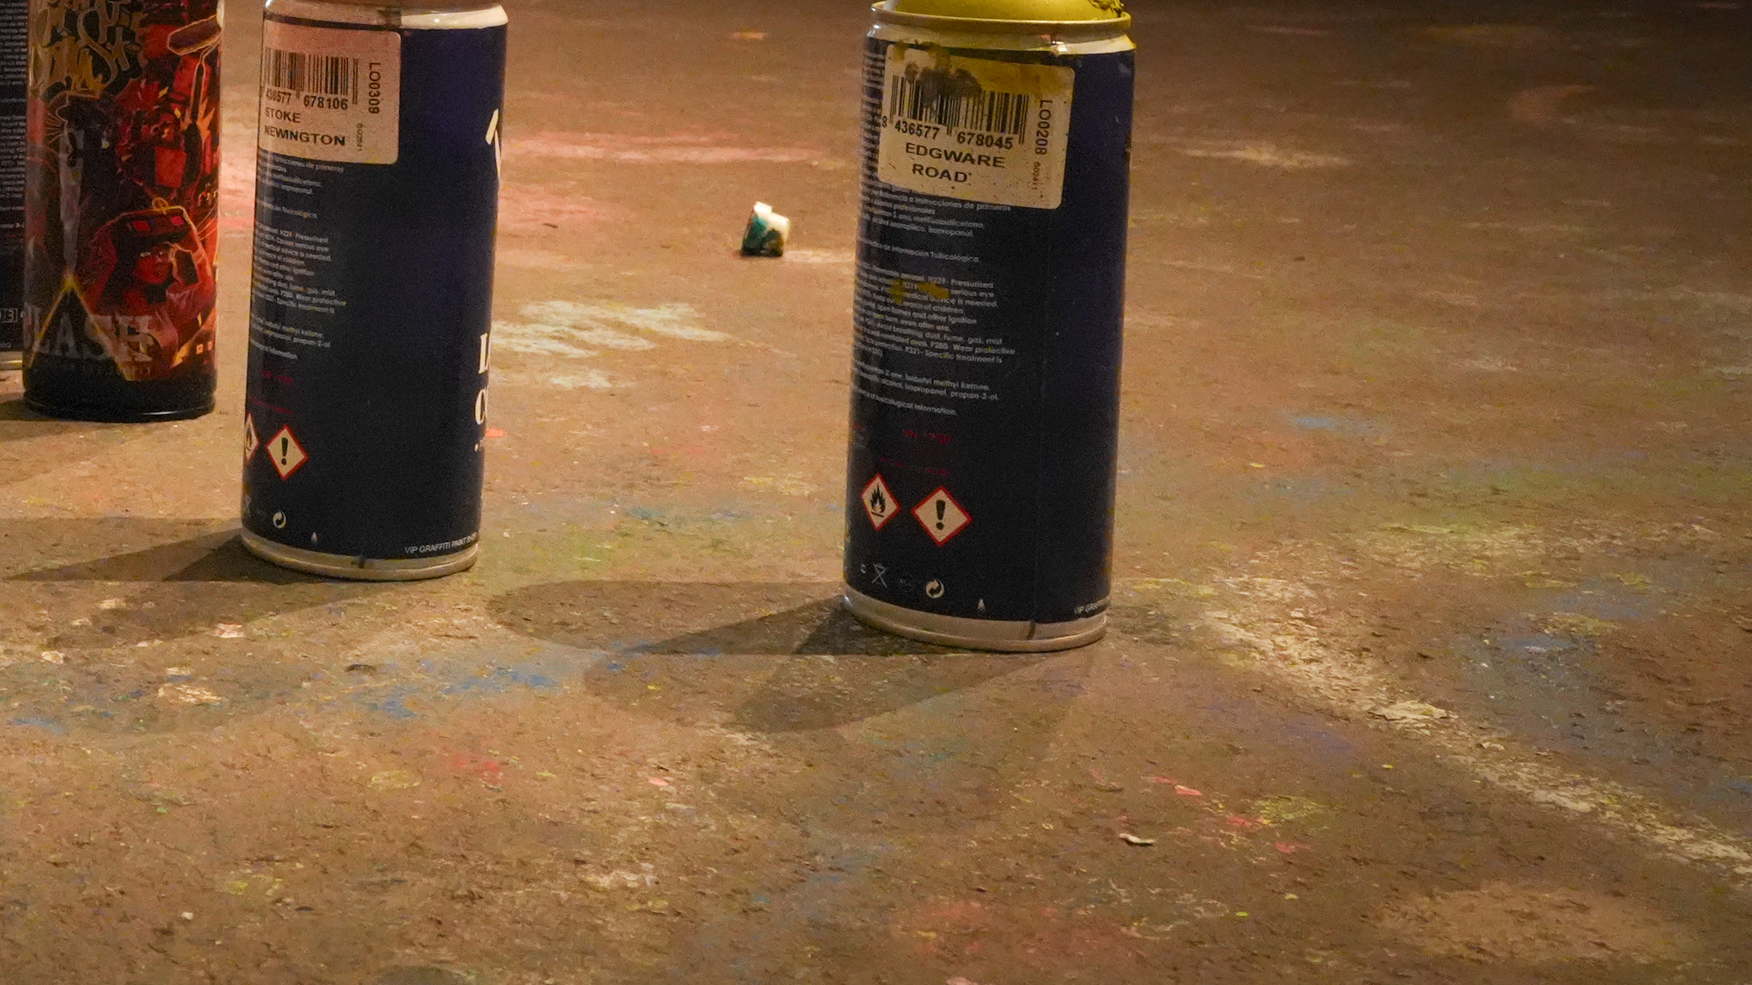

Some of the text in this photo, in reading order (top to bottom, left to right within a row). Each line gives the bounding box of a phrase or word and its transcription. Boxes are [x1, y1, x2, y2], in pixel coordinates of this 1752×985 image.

[368, 62, 381, 114] LO0309
[303, 95, 349, 110] 678106
[264, 107, 301, 124] STOKE
[1035, 99, 1053, 155] LO0208
[895, 119, 940, 140] 436577
[957, 131, 1014, 150] 678045
[905, 142, 1006, 169] EDGWARE
[912, 163, 968, 183] ROAD
[404, 544, 418, 555] VIP
[419, 541, 451, 554] GRAFFITI
